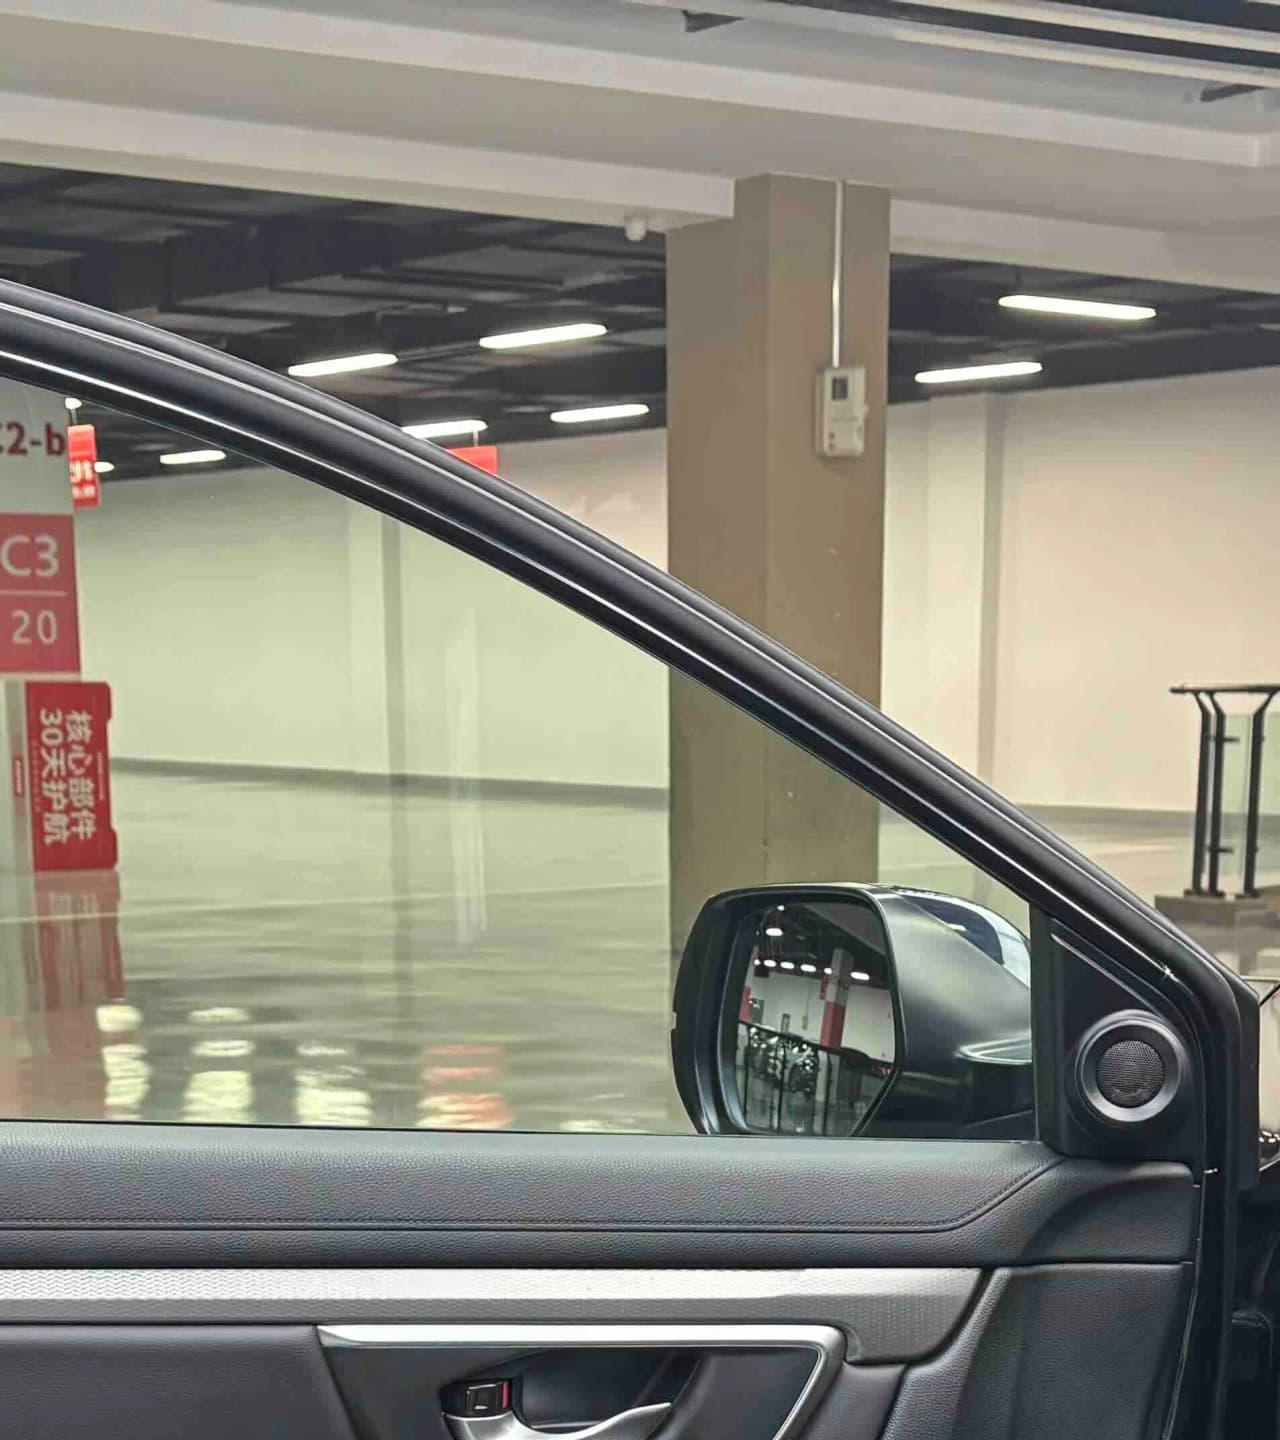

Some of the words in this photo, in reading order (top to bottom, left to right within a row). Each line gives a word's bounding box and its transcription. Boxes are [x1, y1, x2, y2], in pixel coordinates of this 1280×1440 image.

[0, 533, 60, 578] C3
[11, 609, 58, 645] 20
[40, 707, 70, 845] 30天护航
[65, 709, 97, 842] 核心部件
